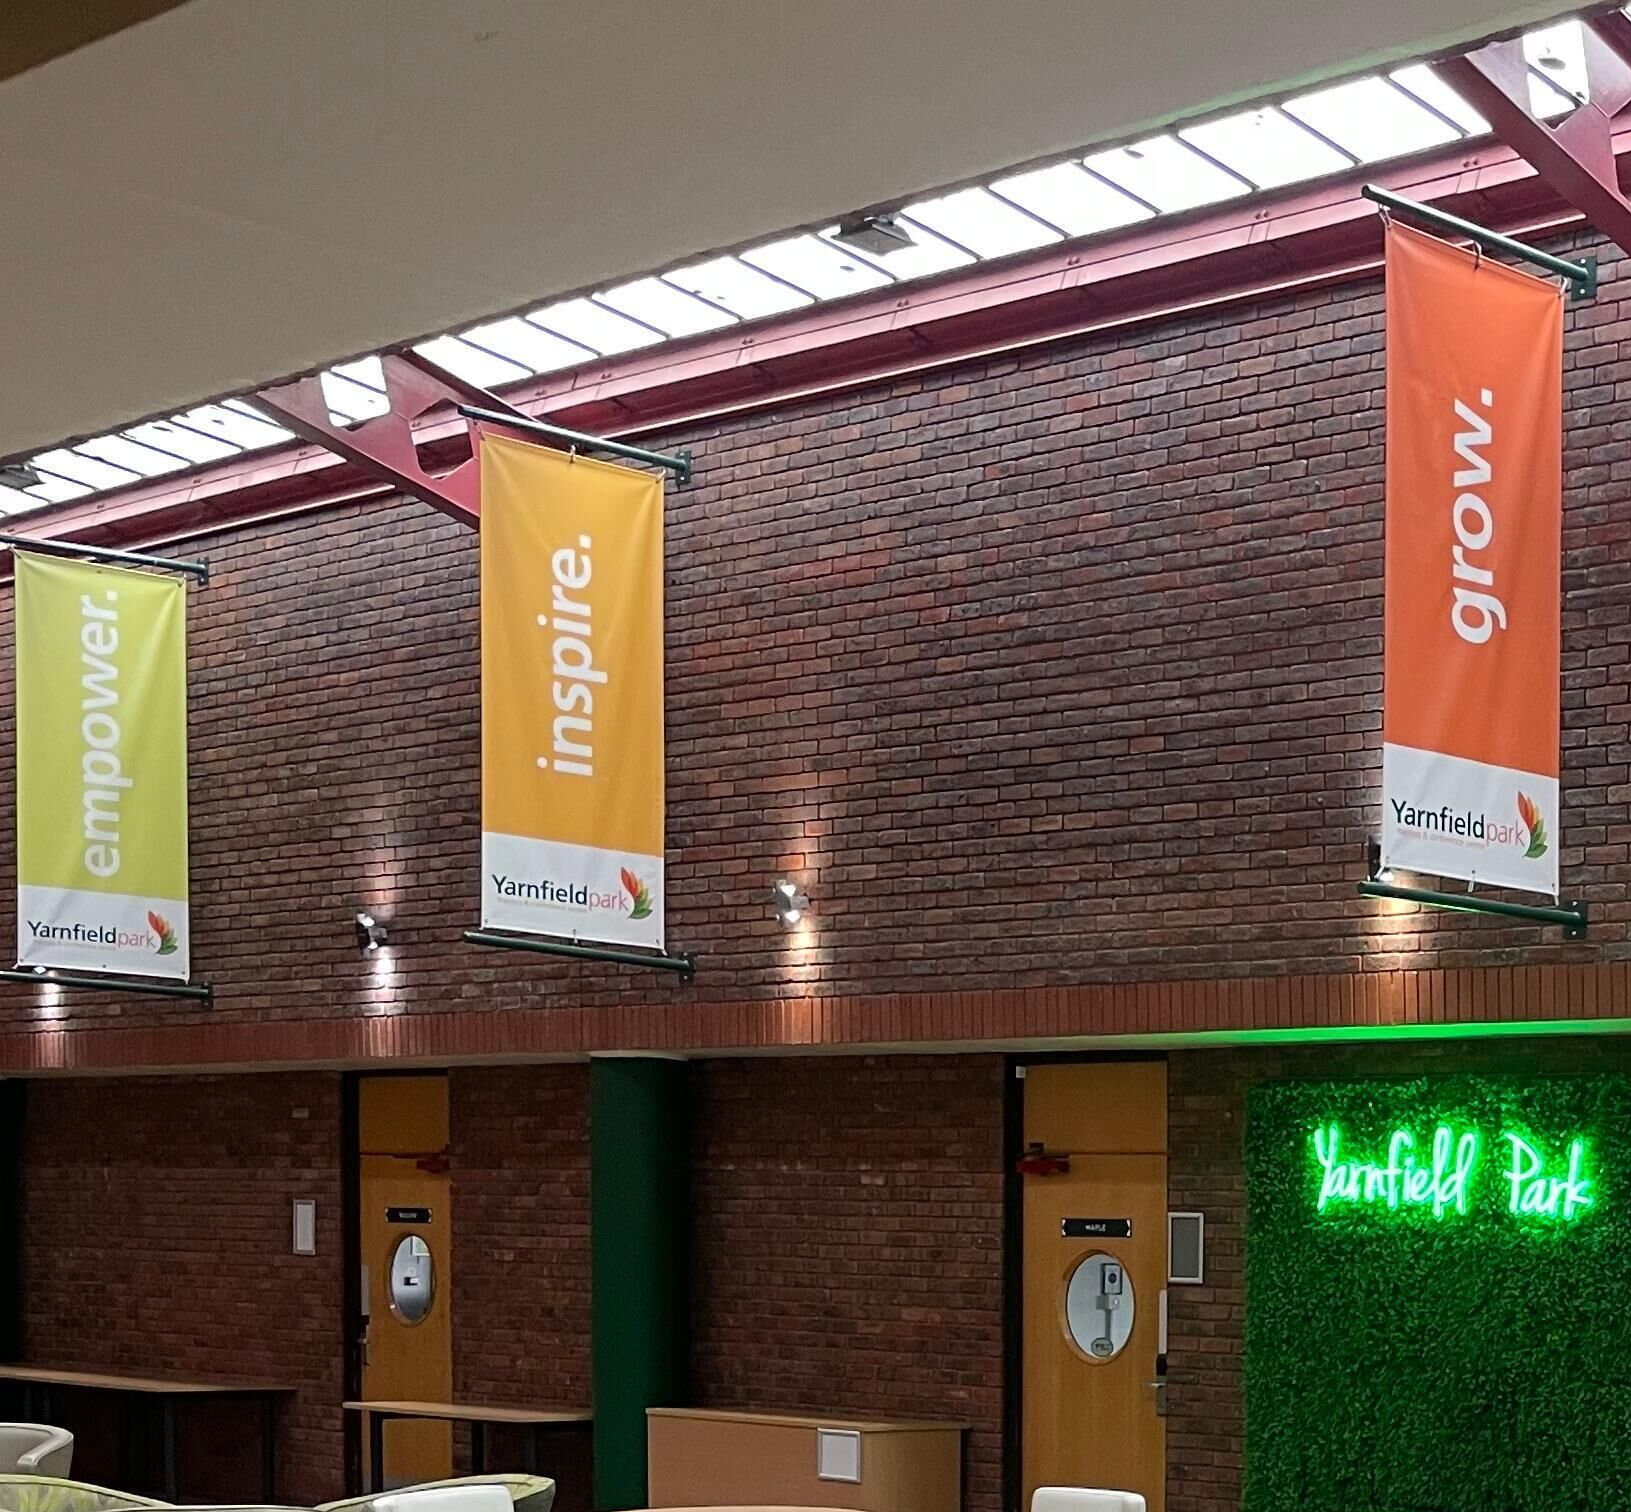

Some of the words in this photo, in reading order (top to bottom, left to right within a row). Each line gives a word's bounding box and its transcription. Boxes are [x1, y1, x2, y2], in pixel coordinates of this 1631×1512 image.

[1450, 386, 1507, 644] grow.
[79, 589, 134, 878] empower.
[536, 533, 609, 778] inspire.
[1313, 1123, 1477, 1222] Yarnfield
[1502, 1130, 1593, 1222] Park
